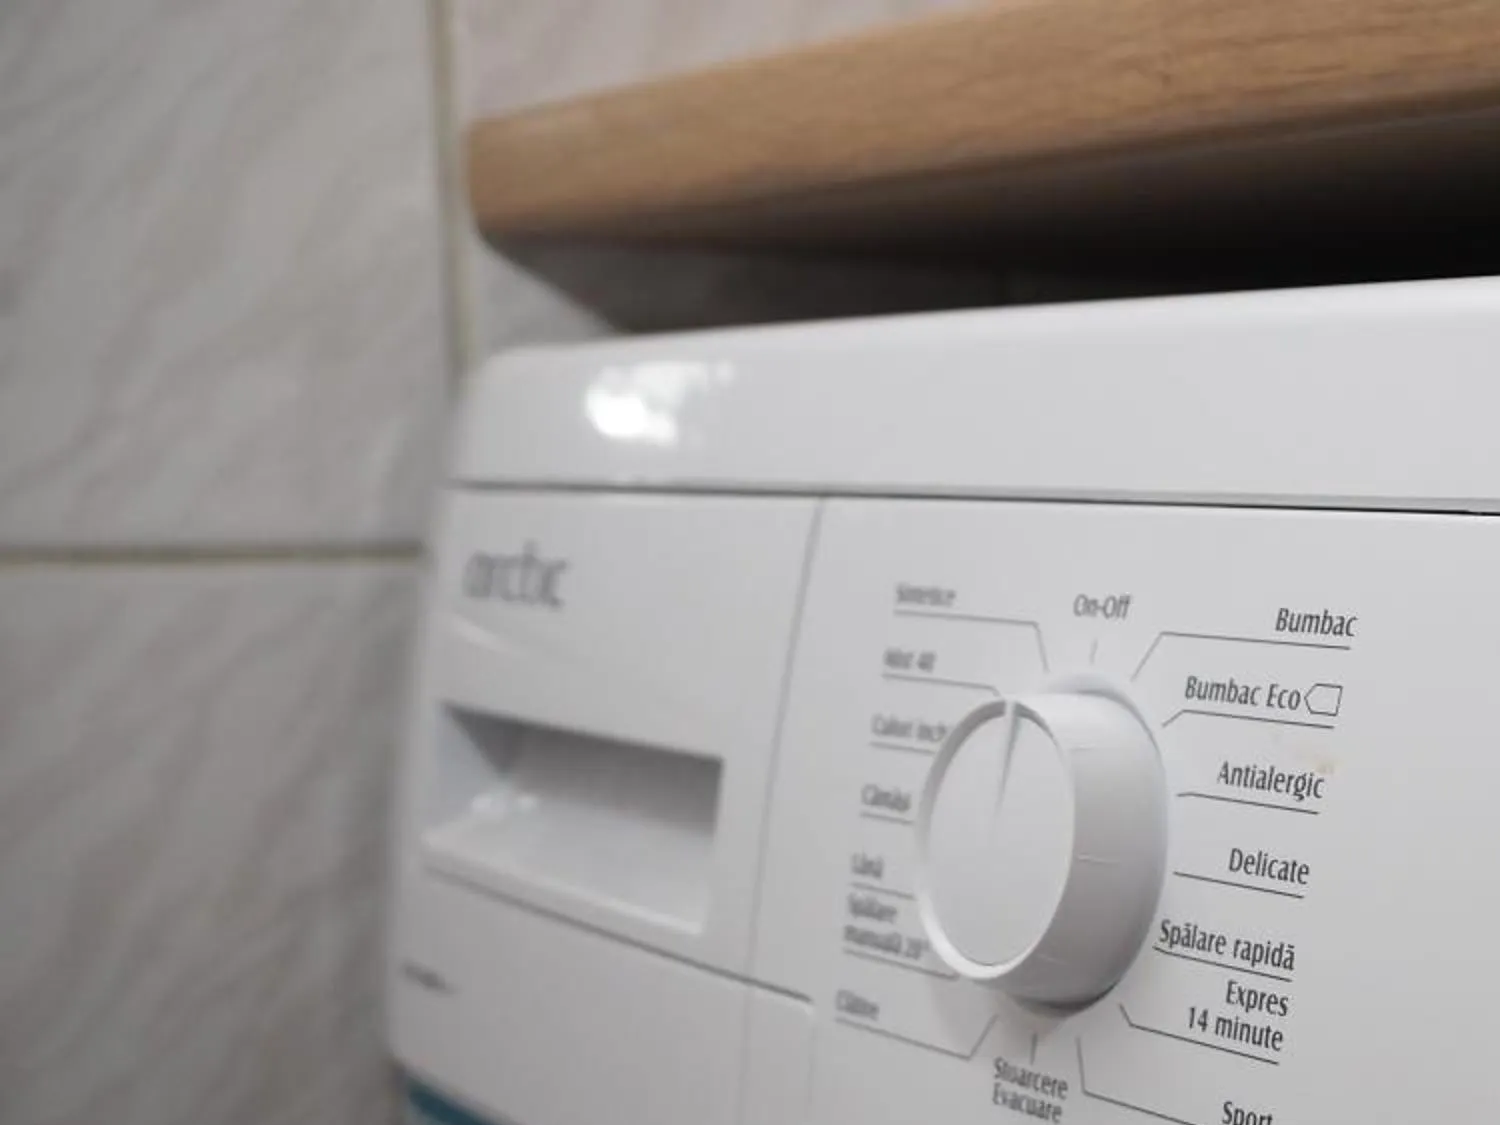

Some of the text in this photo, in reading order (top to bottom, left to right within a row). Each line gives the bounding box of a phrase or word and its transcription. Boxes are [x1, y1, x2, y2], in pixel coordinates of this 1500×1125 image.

[1073, 594, 1132, 619] On-Off
[1275, 607, 1358, 637] Bumbac
[1184, 675, 1301, 710] Bumbac Eco
[1216, 760, 1325, 801] Antialergic
[1228, 847, 1310, 885] Delicate
[1159, 918, 1296, 971] Spălare rapidă
[1225, 979, 1289, 1017] Expres
[1188, 1006, 1284, 1052] 14 minute
[993, 1057, 1069, 1101] Stoarcere
[992, 1081, 1063, 1125] Evacuare
